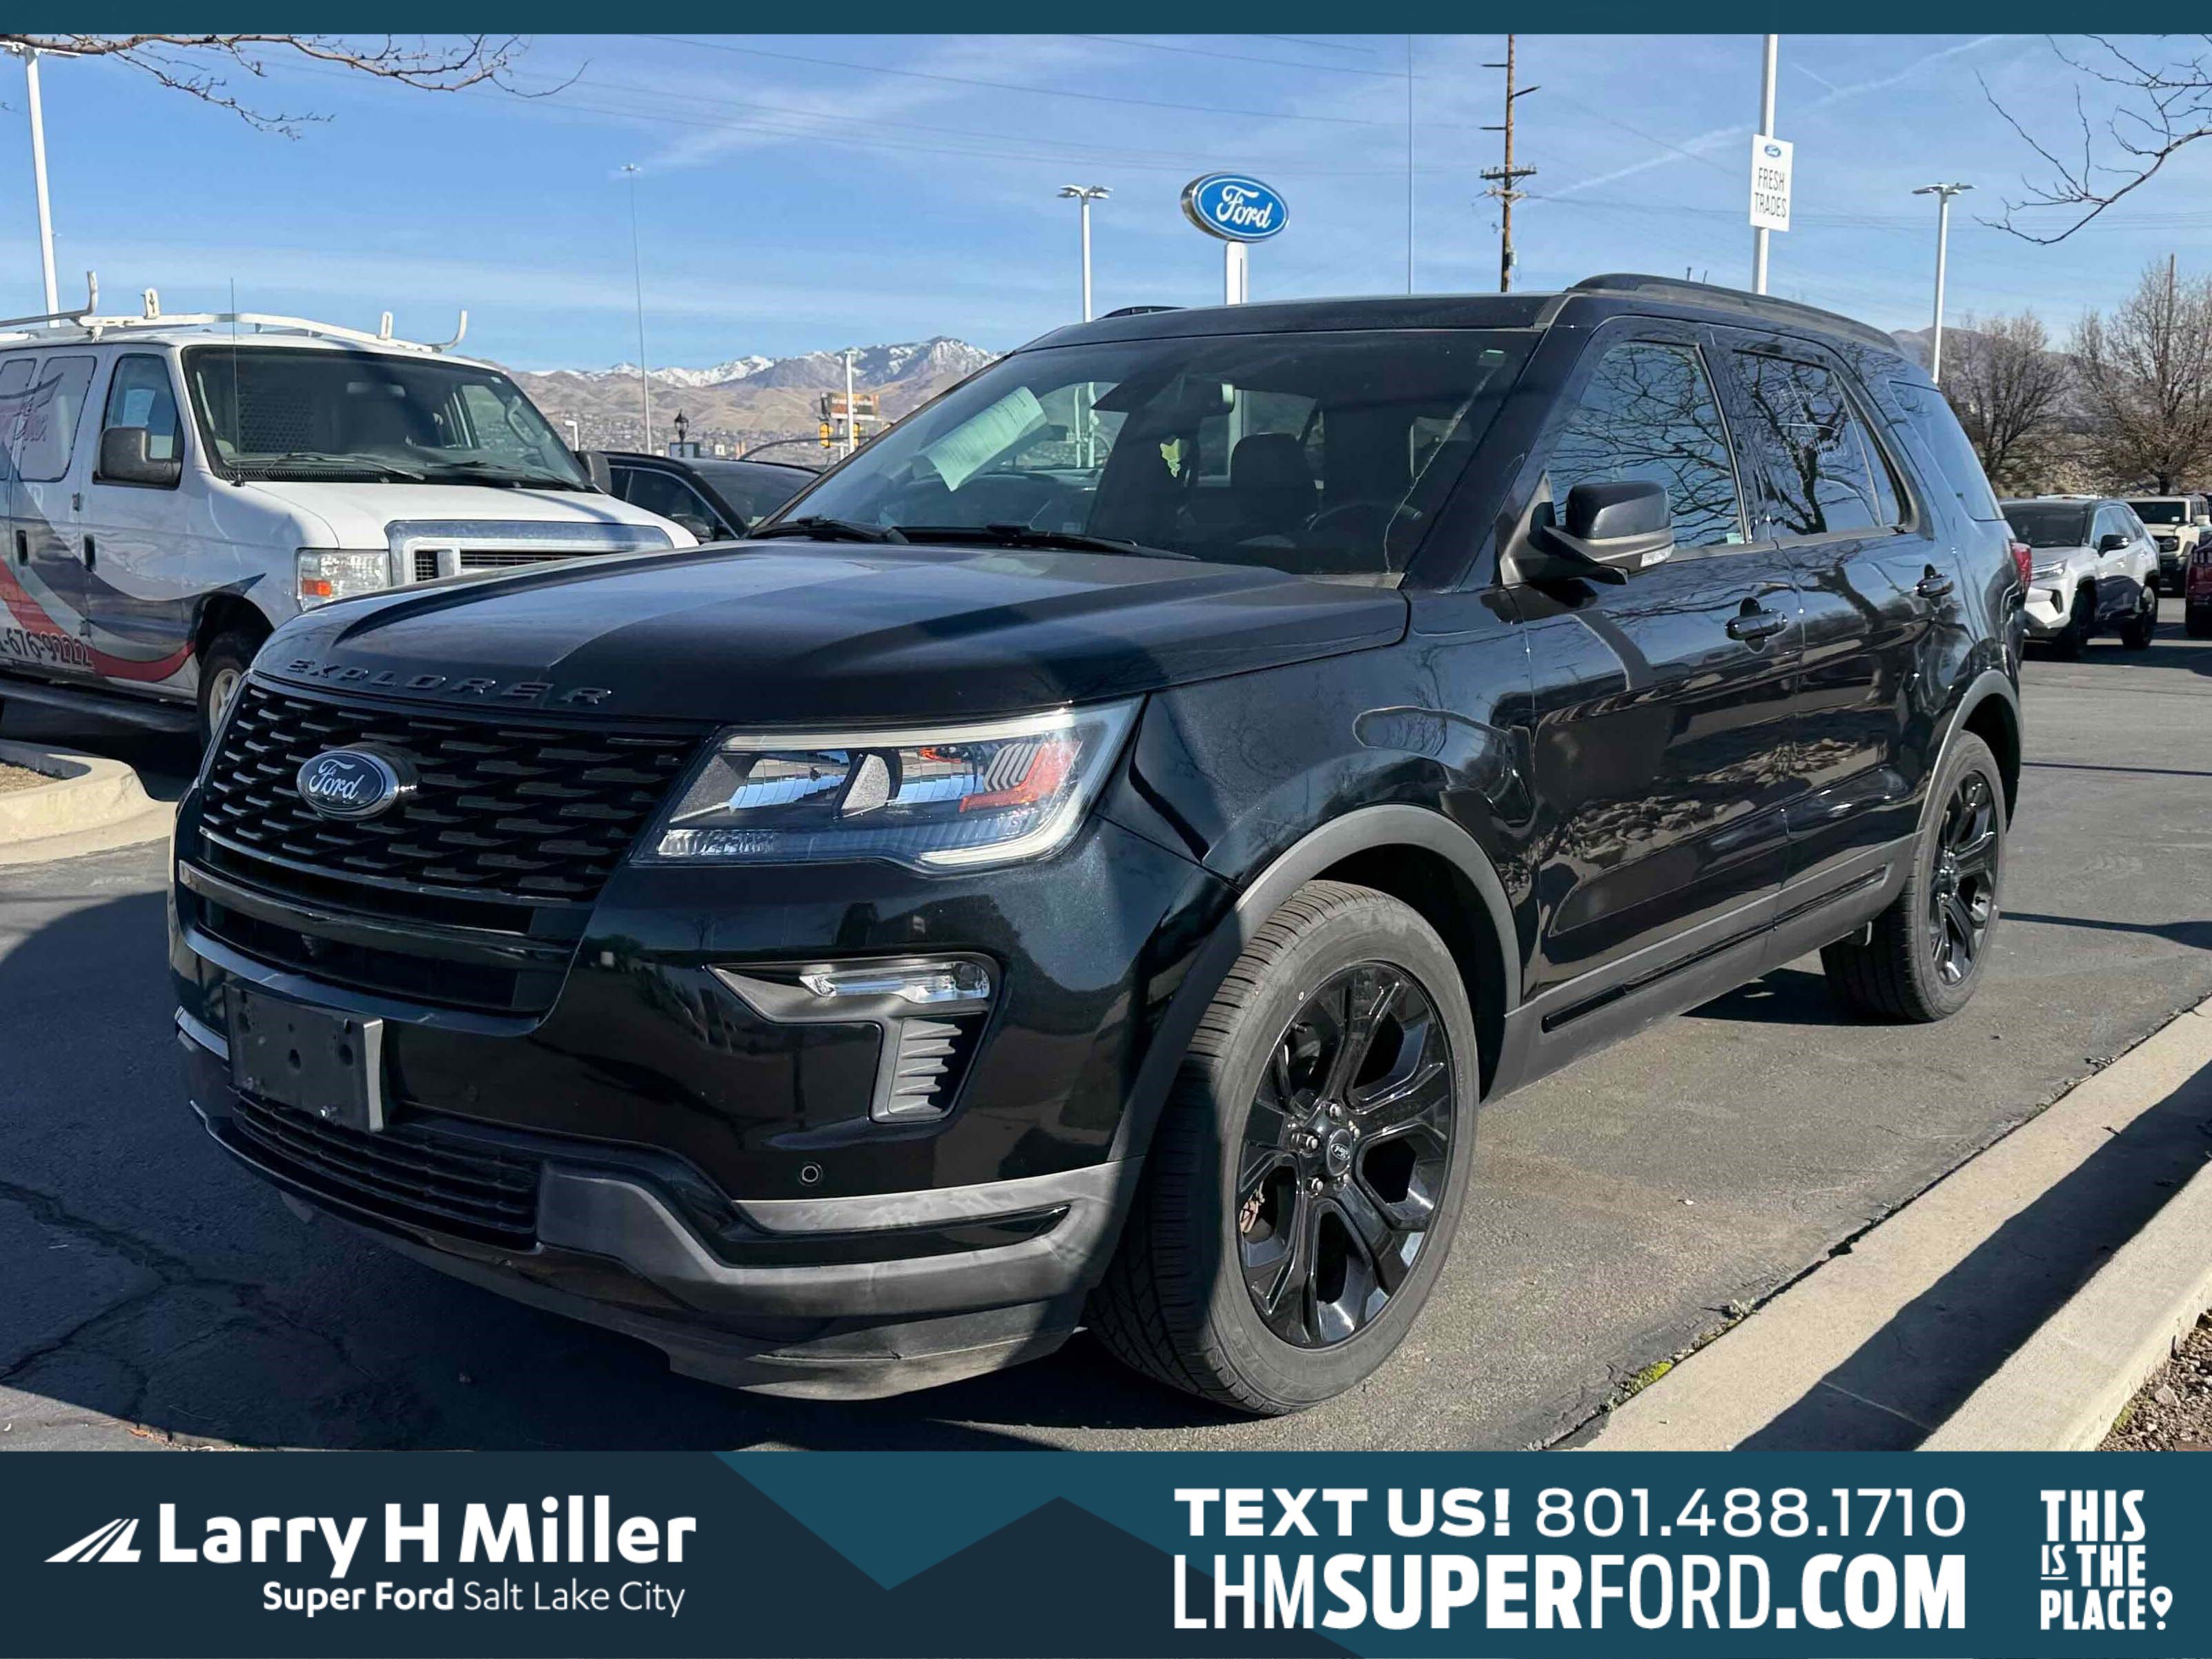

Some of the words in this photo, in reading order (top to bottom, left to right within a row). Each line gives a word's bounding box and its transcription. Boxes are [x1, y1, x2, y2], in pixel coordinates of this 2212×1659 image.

[1757, 167, 1785, 193] FRESH
[1215, 184, 1274, 228] Ford
[1754, 192, 1787, 218] TRADES
[286, 659, 613, 705] EXPLORER
[308, 758, 367, 801] Ford
